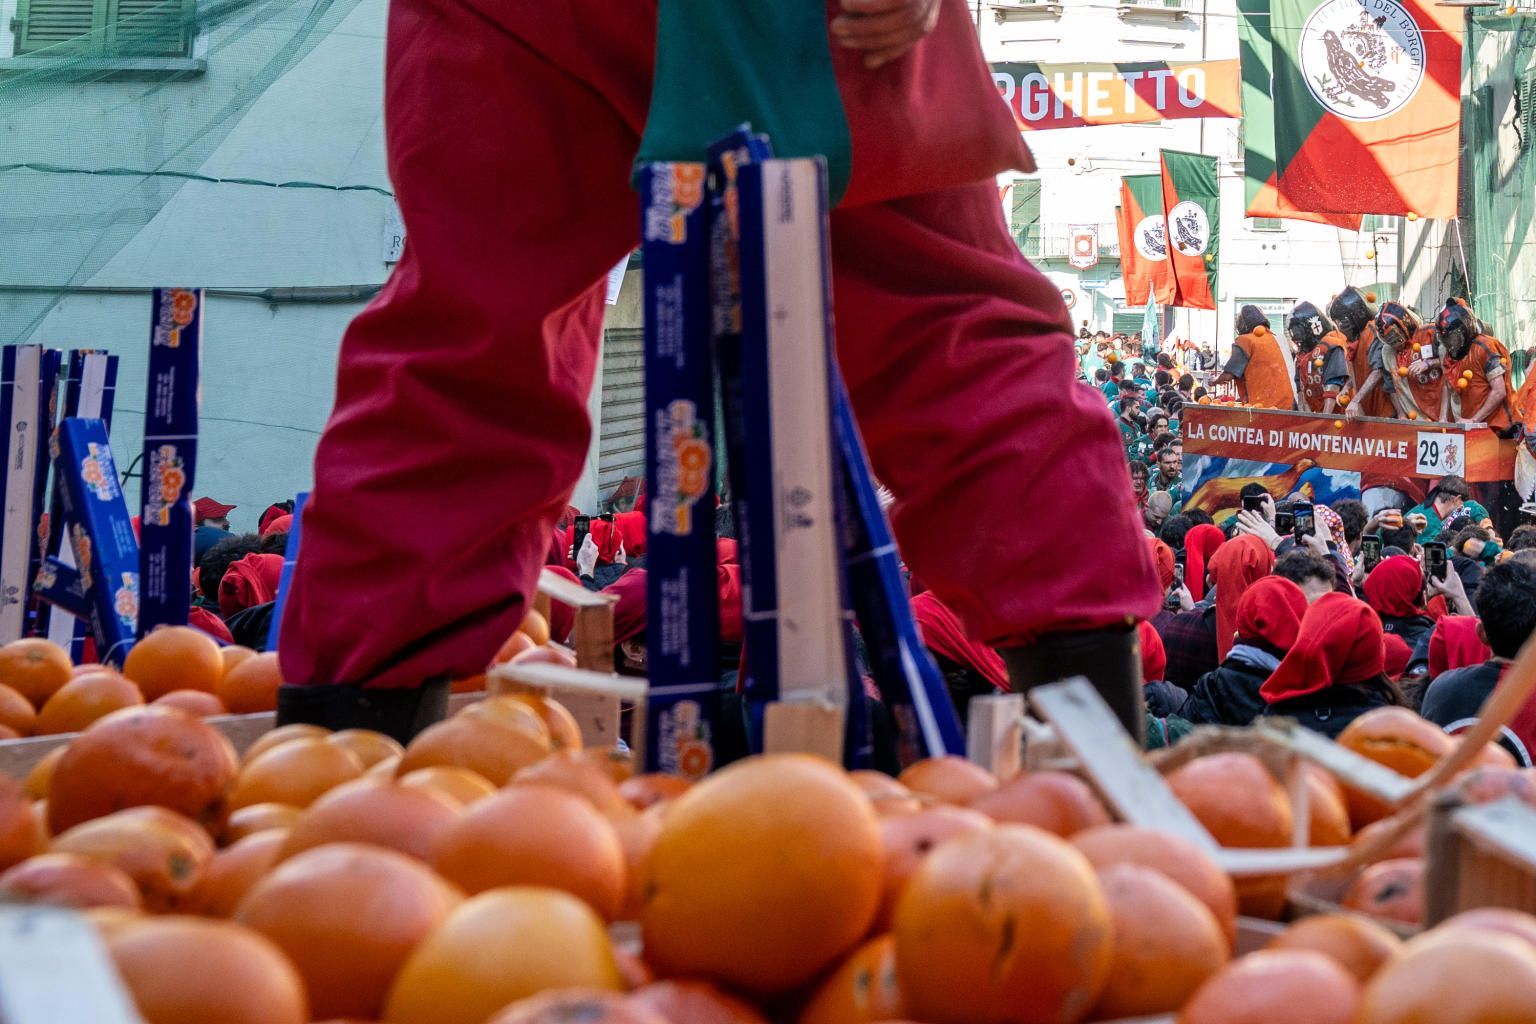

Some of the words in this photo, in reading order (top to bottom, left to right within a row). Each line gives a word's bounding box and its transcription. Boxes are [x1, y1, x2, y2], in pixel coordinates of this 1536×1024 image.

[1373, 0, 1397, 19] DEL
[991, 68, 1206, 122] RGHETTO
[1188, 422, 1205, 440] LA
[1209, 424, 1265, 446] CONTEA
[1269, 429, 1284, 448] DI
[1288, 431, 1409, 459] MONTENAVALE
[1419, 439, 1439, 467] 29
